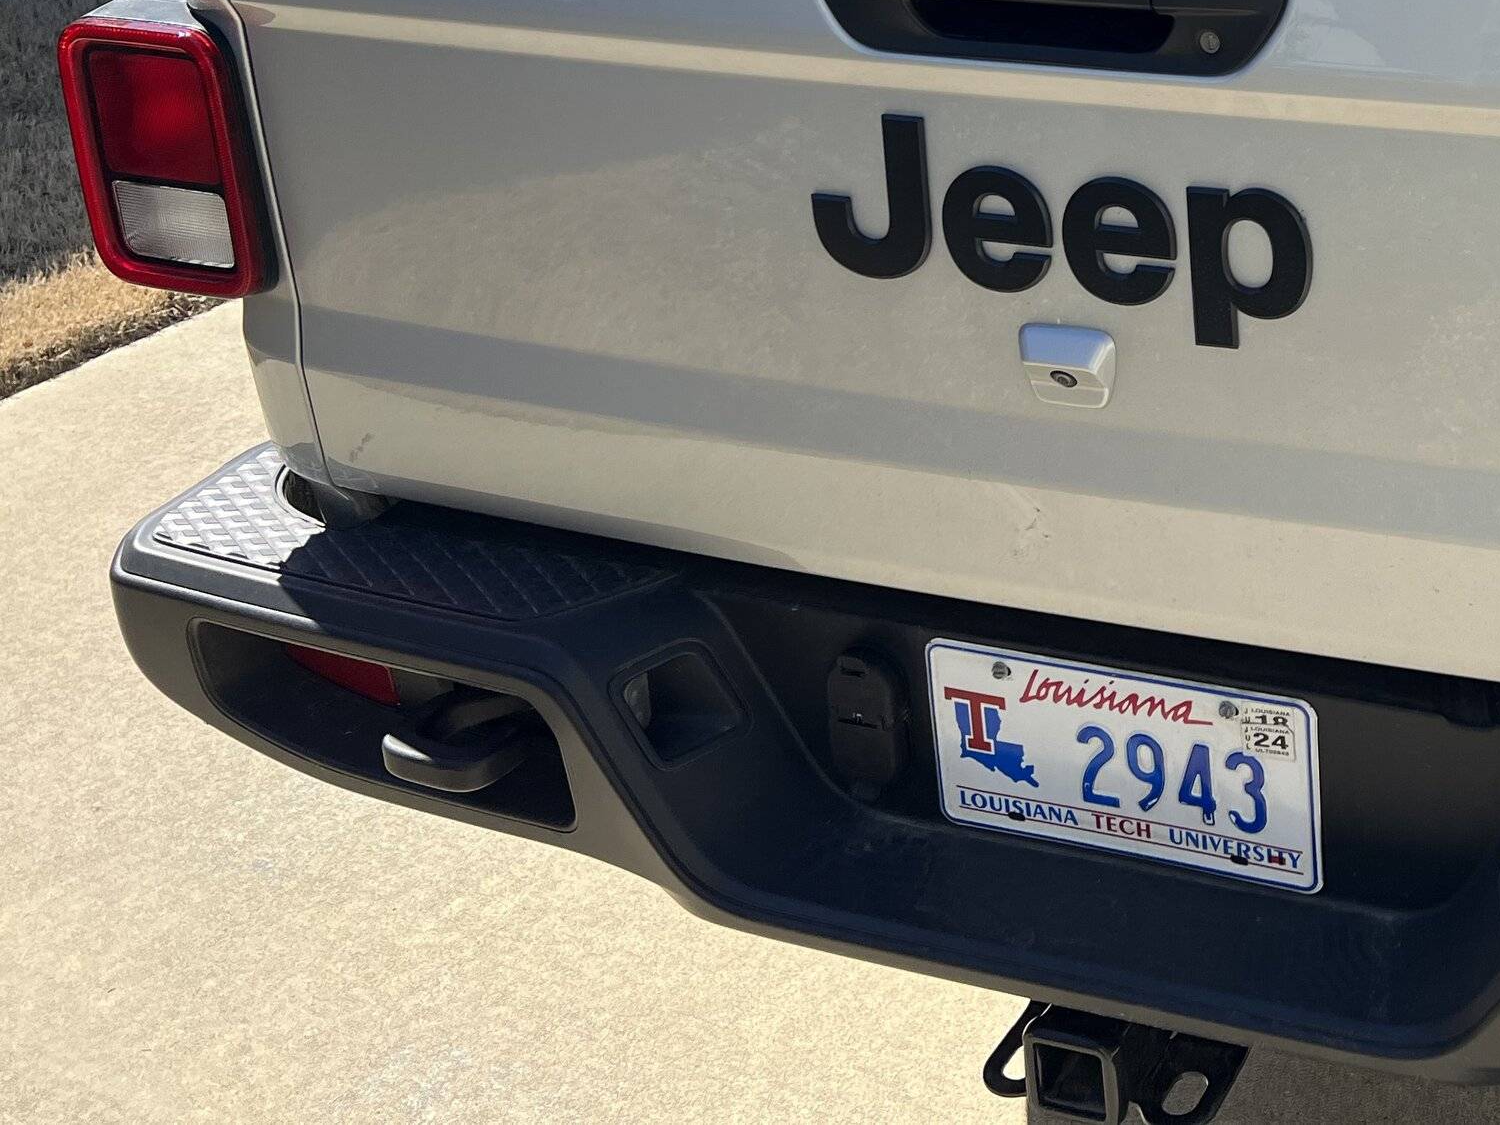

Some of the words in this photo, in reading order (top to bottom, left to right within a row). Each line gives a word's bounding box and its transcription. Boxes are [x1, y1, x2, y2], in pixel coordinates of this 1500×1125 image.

[811, 113, 1314, 350] Jeep
[1018, 668, 1214, 726] Louisiana
[1253, 732, 1289, 750] 24
[1075, 723, 1268, 835] 2943
[959, 789, 1080, 827] LOUISIANA
[1090, 812, 1152, 839] TECH
